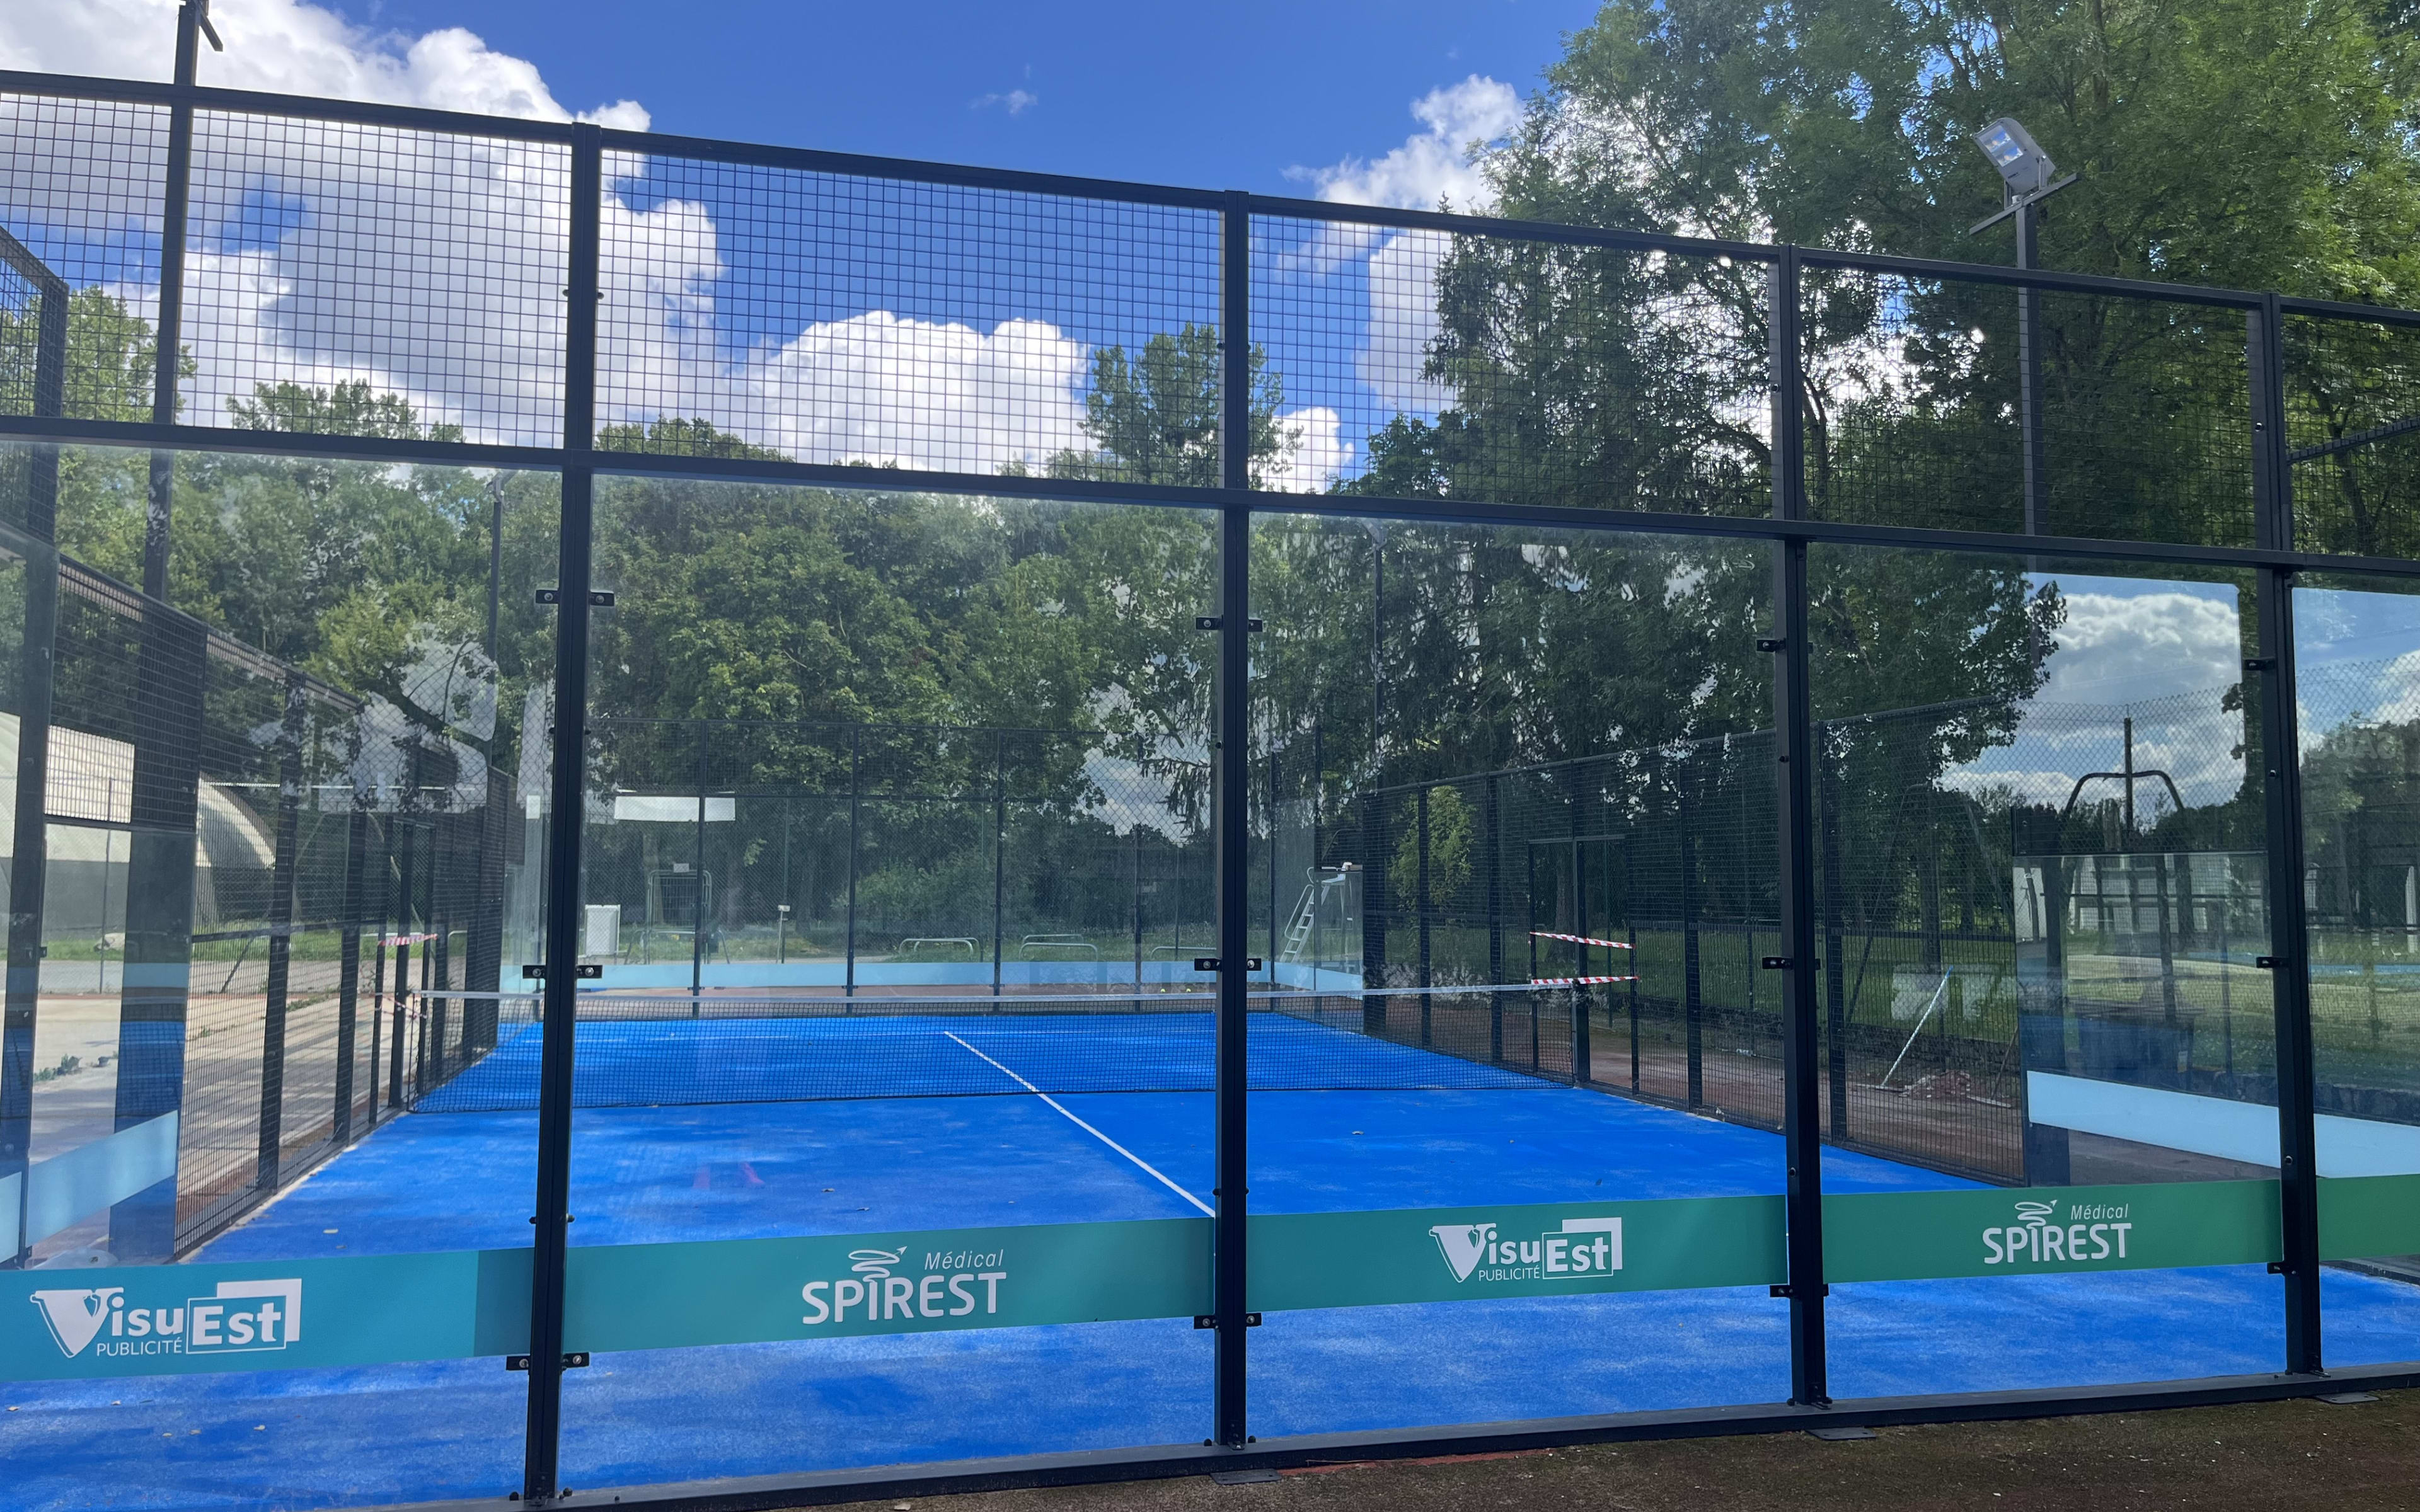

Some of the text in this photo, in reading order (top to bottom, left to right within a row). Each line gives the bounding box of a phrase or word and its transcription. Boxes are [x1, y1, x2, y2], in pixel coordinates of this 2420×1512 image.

[2071, 1203, 2129, 1220] Médical
[1982, 1222, 2132, 1264] SPIREST
[925, 1249, 1004, 1271] Médical
[1478, 1264, 1540, 1281] PUBLICITÉ
[802, 1272, 1007, 1325] SPIREST
[96, 1337, 182, 1357] PUBLICITÉ
